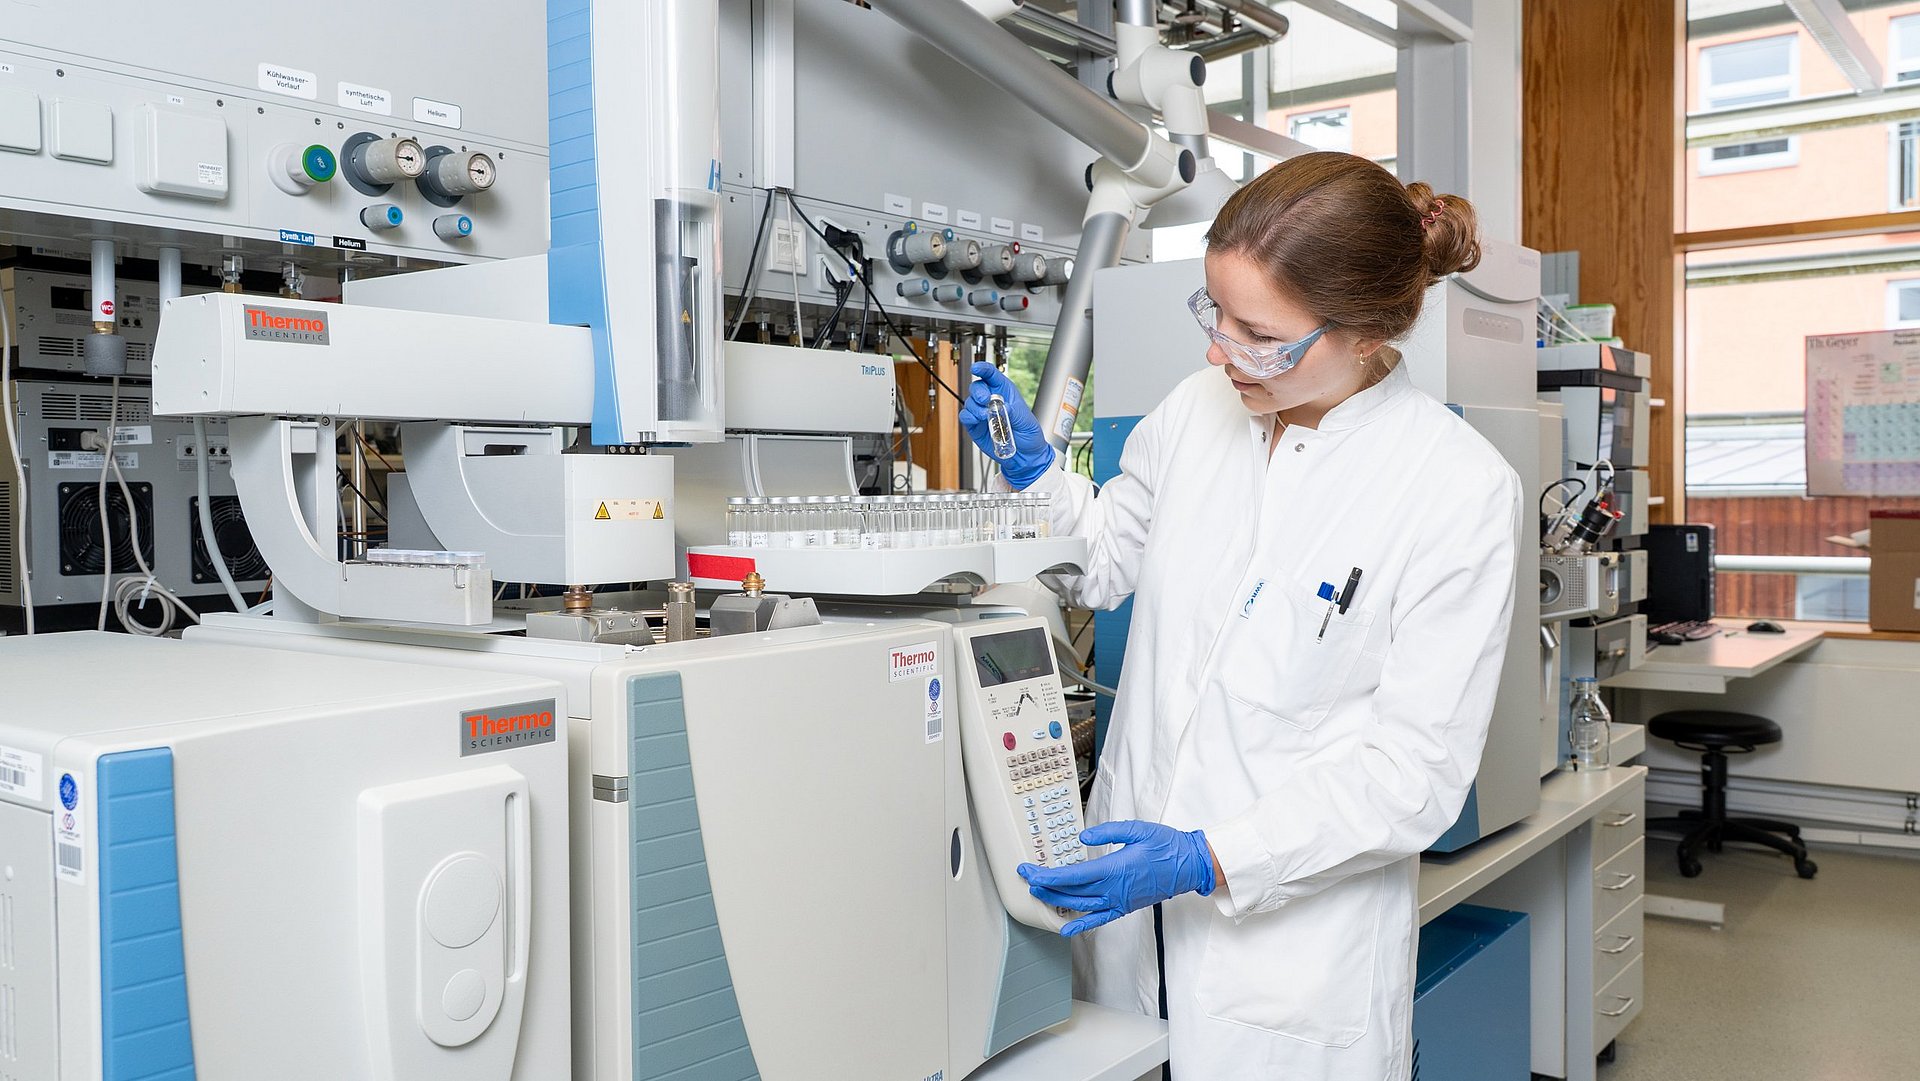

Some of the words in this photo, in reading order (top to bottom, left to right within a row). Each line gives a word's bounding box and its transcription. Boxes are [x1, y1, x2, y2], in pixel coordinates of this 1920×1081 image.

[266, 69, 309, 84] Kühlwasser-
[276, 80, 300, 90] Vorlauf
[345, 89, 385, 102] synthetische
[360, 99, 373, 107] Luft
[427, 109, 447, 118] Helium
[281, 231, 301, 242] Synth.
[301, 235, 314, 244] Luft
[338, 239, 361, 248] Helium
[246, 309, 325, 332] Thermo
[252, 329, 323, 341] SCIENTIFIC
[1826, 337, 1859, 350] Geyer
[892, 650, 935, 668] Thermo
[893, 664, 934, 677] SCIENTIFIC
[466, 711, 552, 737] Thermo
[471, 729, 551, 748] SCIENTIFIC
